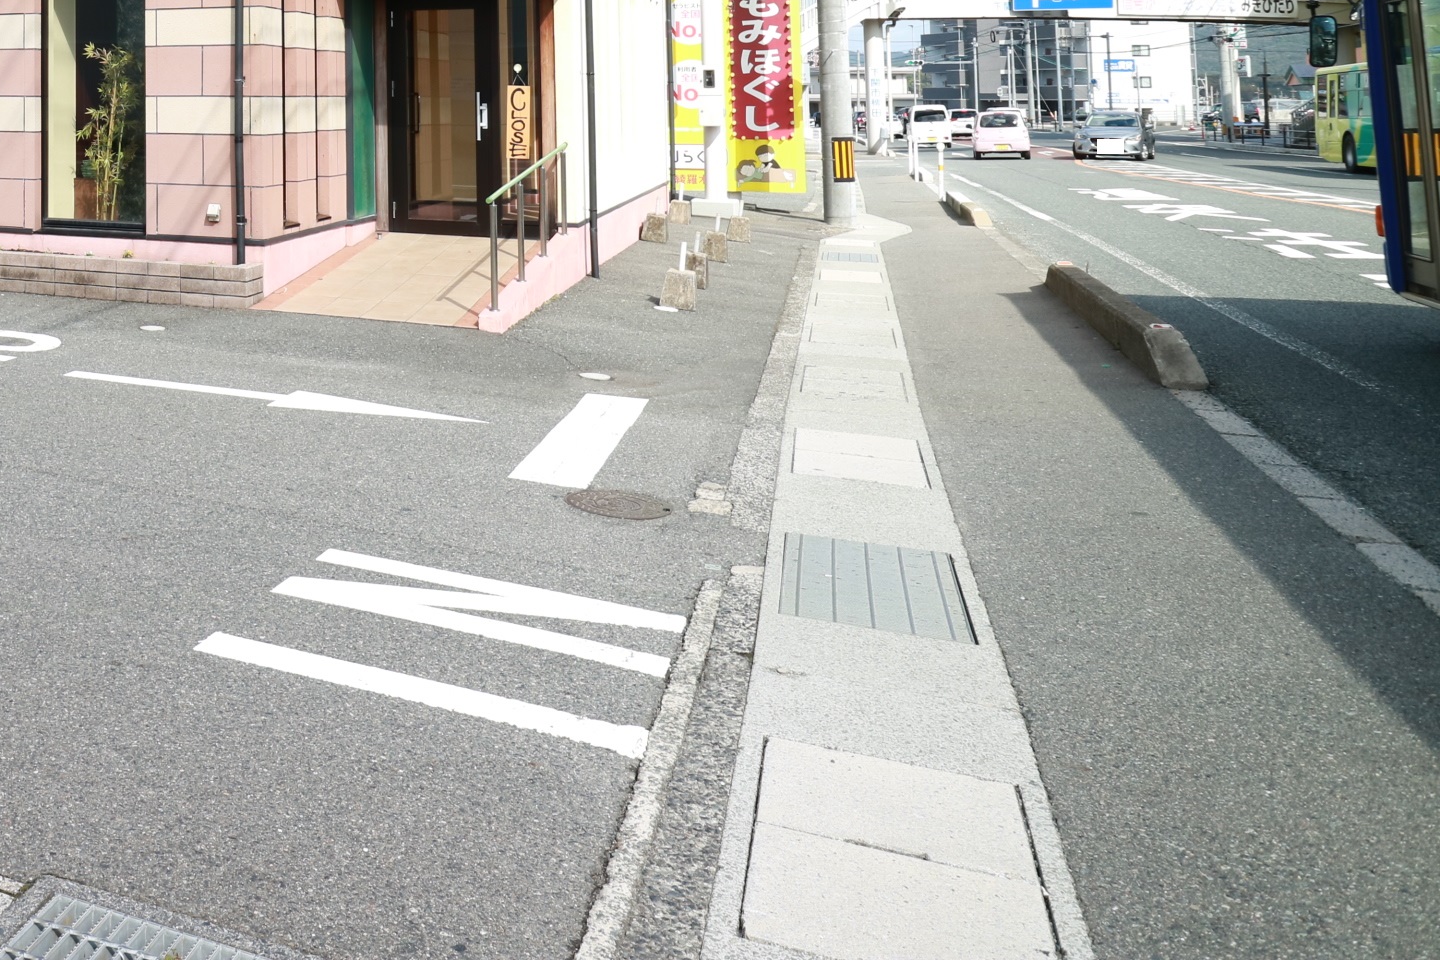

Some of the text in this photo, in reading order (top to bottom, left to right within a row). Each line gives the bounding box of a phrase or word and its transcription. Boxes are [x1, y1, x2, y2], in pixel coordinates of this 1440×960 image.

[509, 87, 527, 158] CLOSE
[1068, 187, 1394, 290] 追突注
